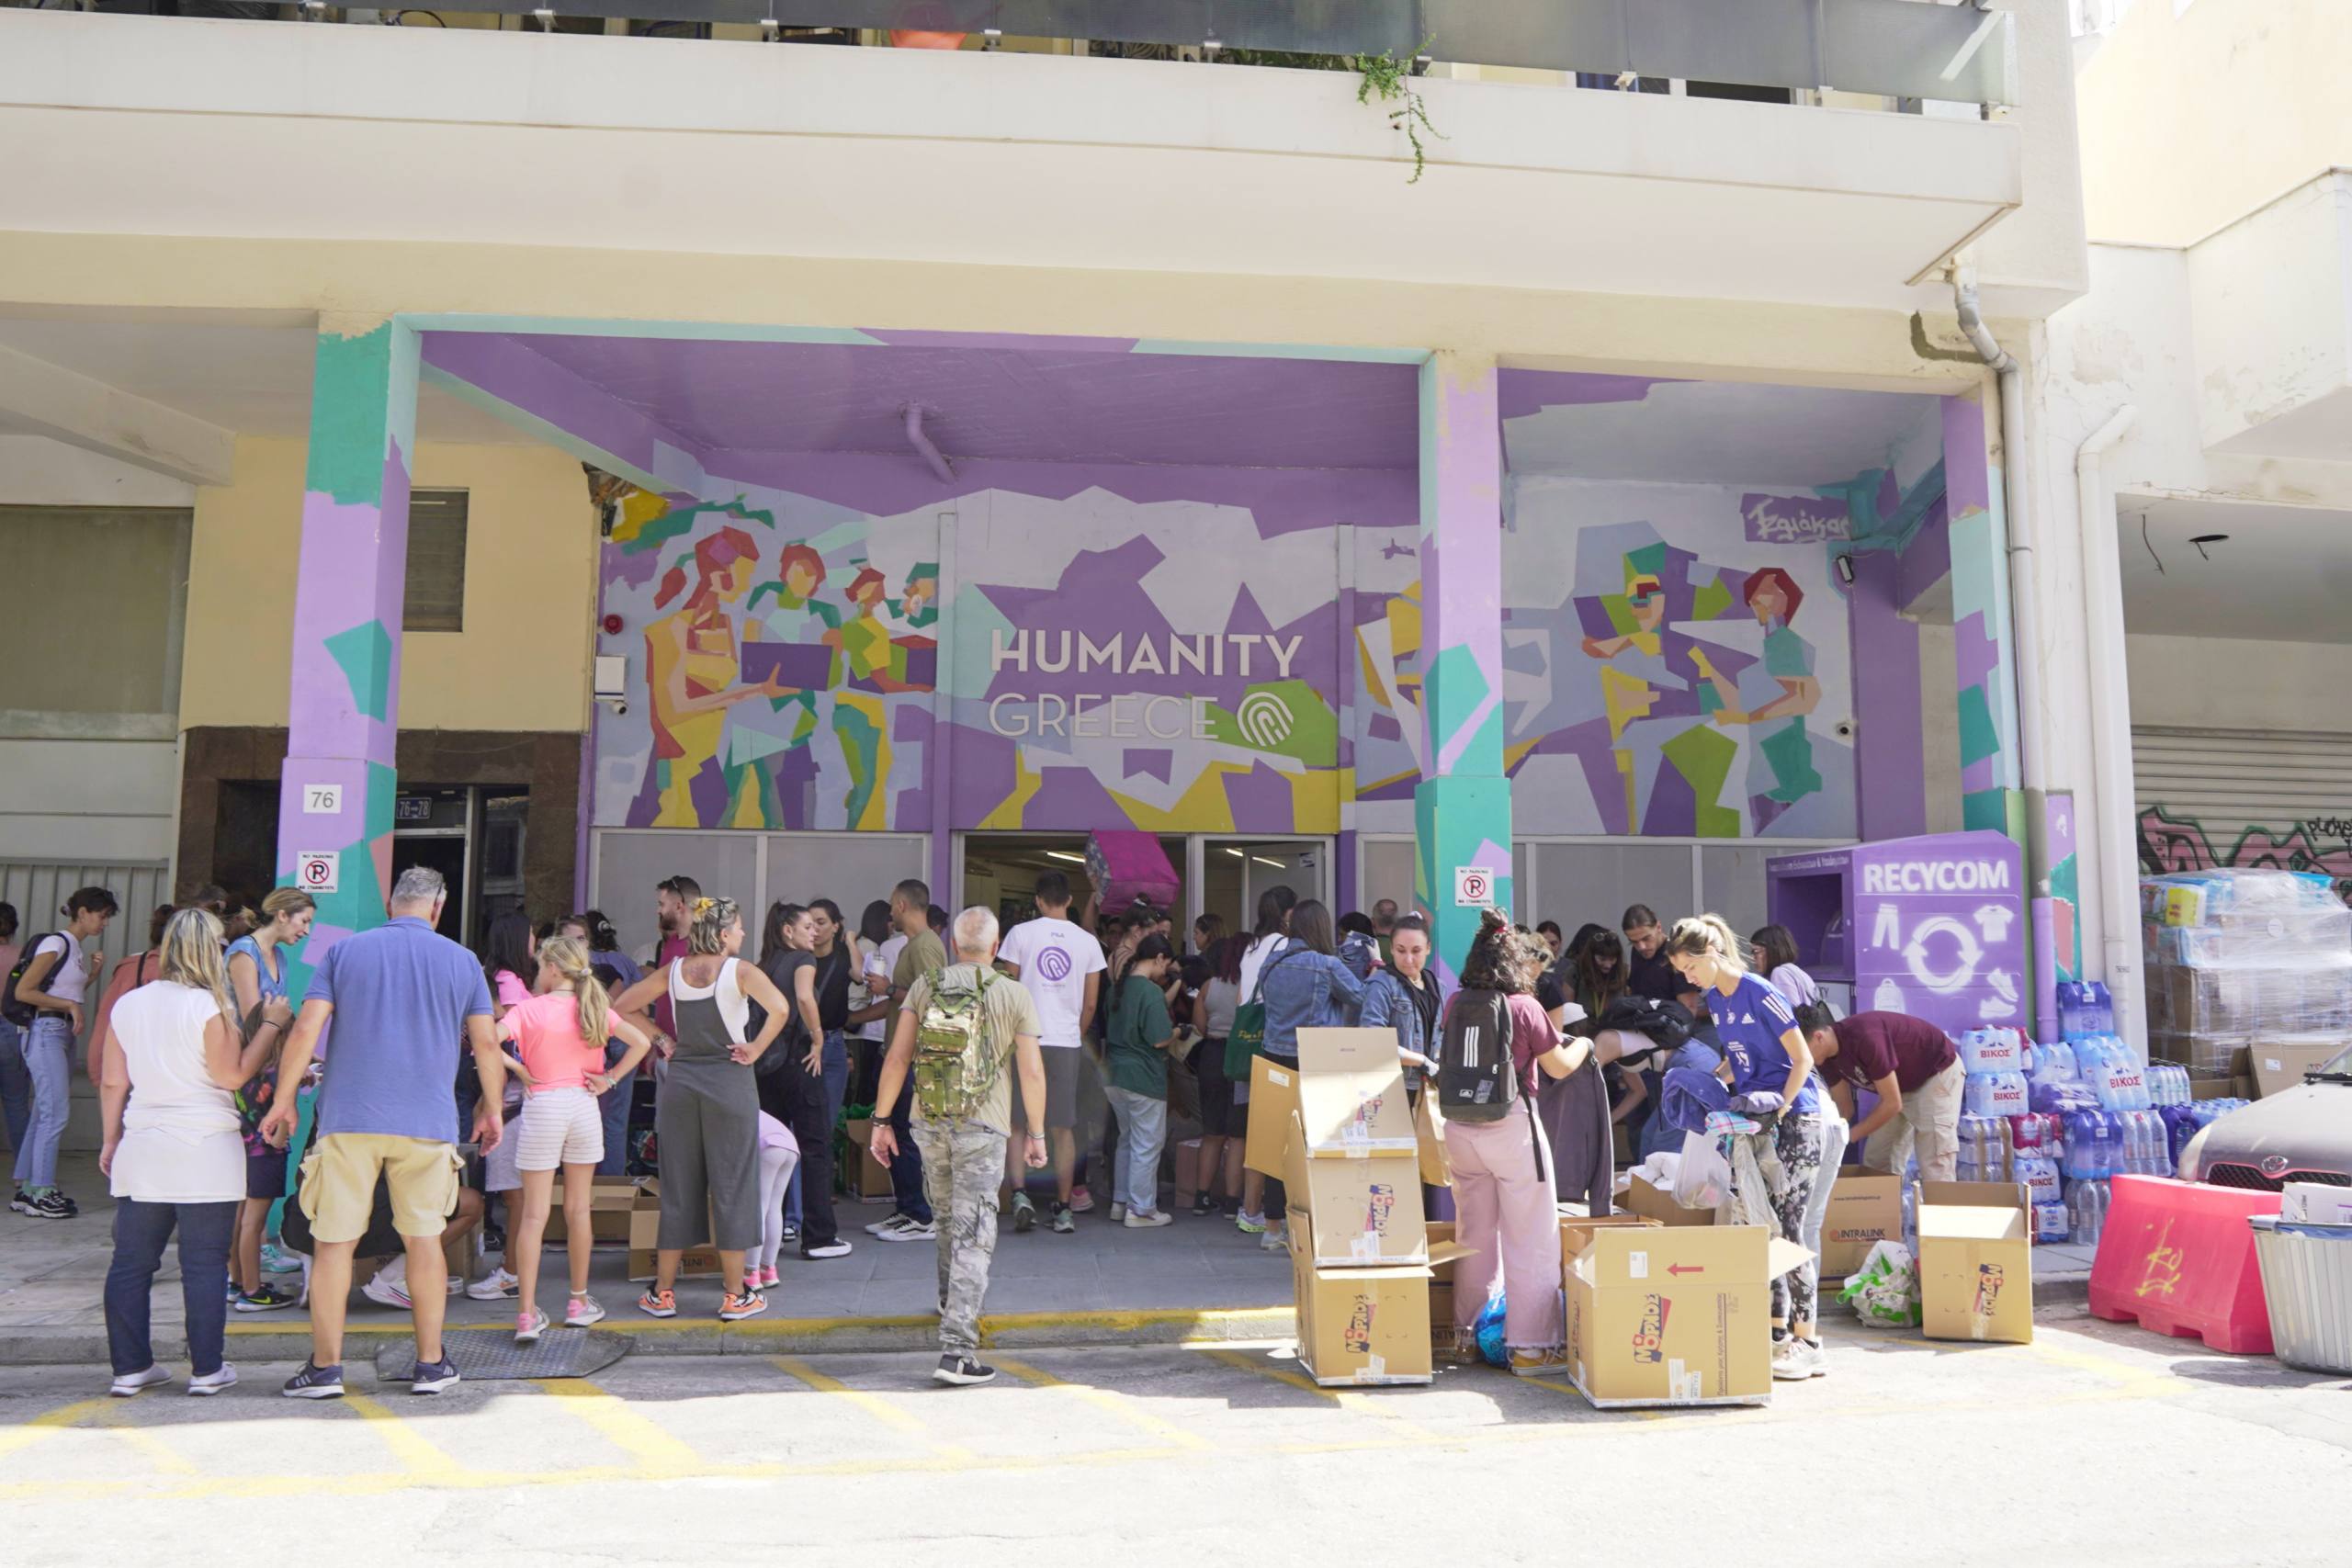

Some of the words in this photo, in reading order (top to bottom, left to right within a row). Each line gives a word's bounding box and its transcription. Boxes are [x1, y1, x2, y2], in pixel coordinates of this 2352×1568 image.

[991, 628, 1303, 677] HUMANITY
[989, 692, 1219, 739] GREECE
[311, 792, 334, 808] 76
[1863, 860, 2009, 893] RECYCOM
[1980, 1049, 2011, 1058] ΒΙΚΟΣ
[2109, 1076, 2142, 1089] ΒΙΚΟΣ
[1993, 1092, 2021, 1100] ΒΙΚΟΣ
[1840, 1228, 1886, 1238] INTRALINK
